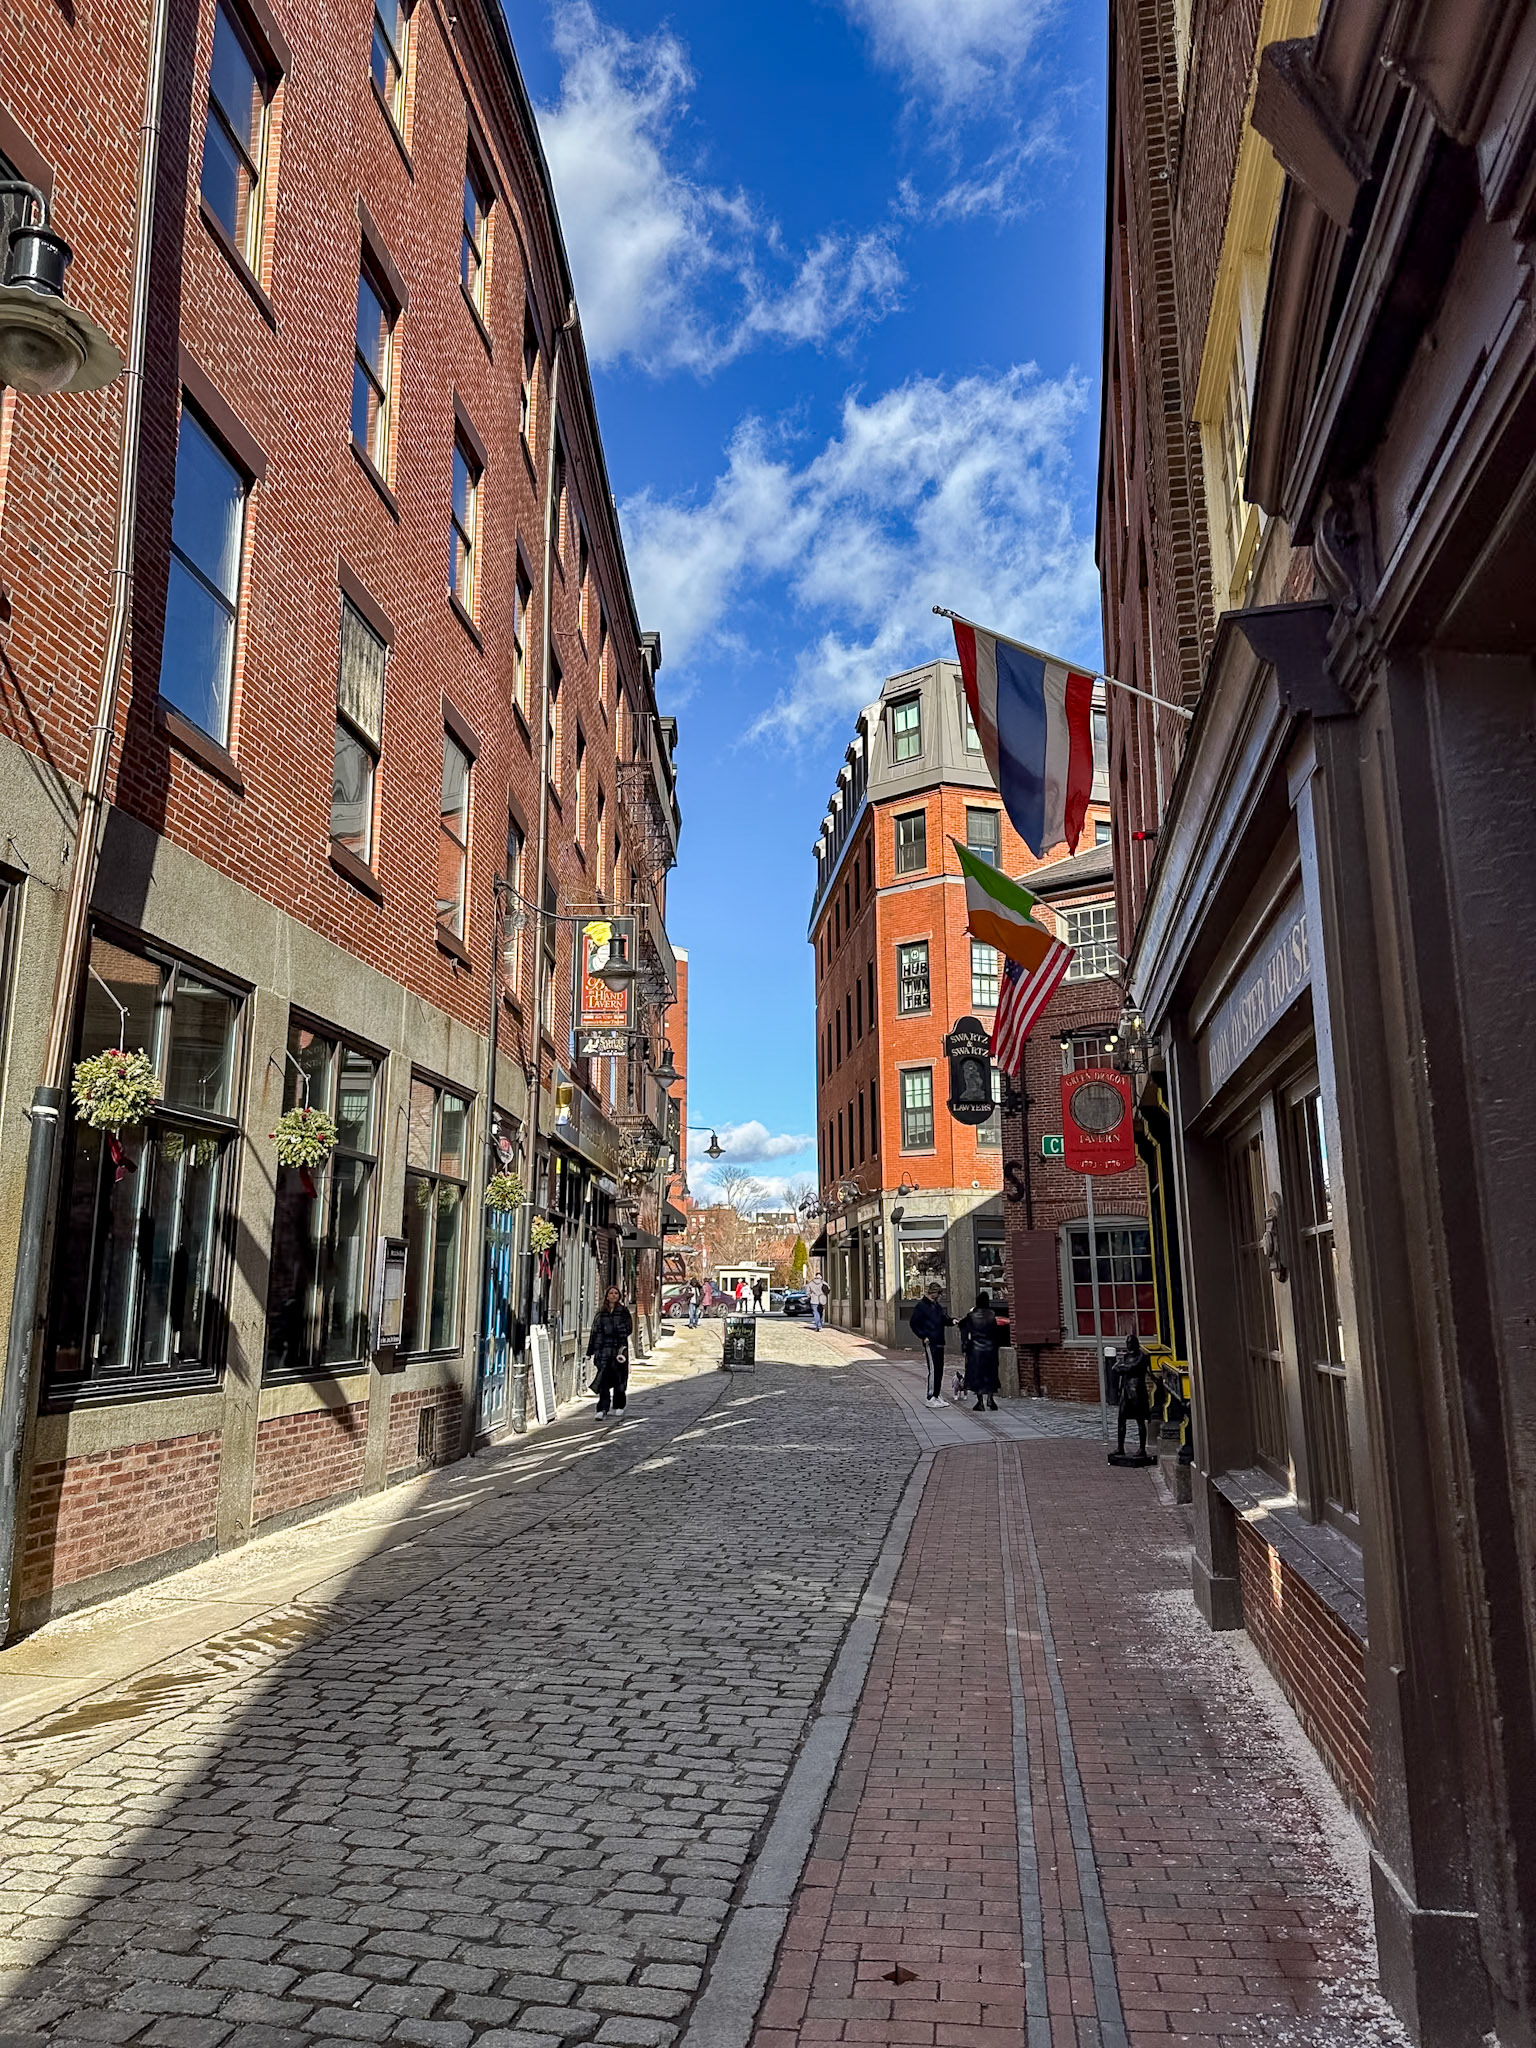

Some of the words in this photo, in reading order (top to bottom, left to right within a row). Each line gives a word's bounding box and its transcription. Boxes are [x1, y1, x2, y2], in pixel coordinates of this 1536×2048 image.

[903, 962, 928, 977] HUB
[585, 995, 624, 1009] TAVERN
[595, 991, 624, 1001] HAND
[1209, 1031, 1232, 1087] UNION
[1231, 976, 1268, 1059] OYSTER
[1268, 914, 1311, 1013] HOUSE
[950, 1032, 989, 1045] SWARTZ
[951, 1046, 990, 1058] SWARTZ
[1065, 1072, 1092, 1087] GREEN
[1094, 1072, 1126, 1086] DRAGON
[952, 1103, 992, 1112] LAWYERS
[1079, 1133, 1121, 1144] TAVERN
